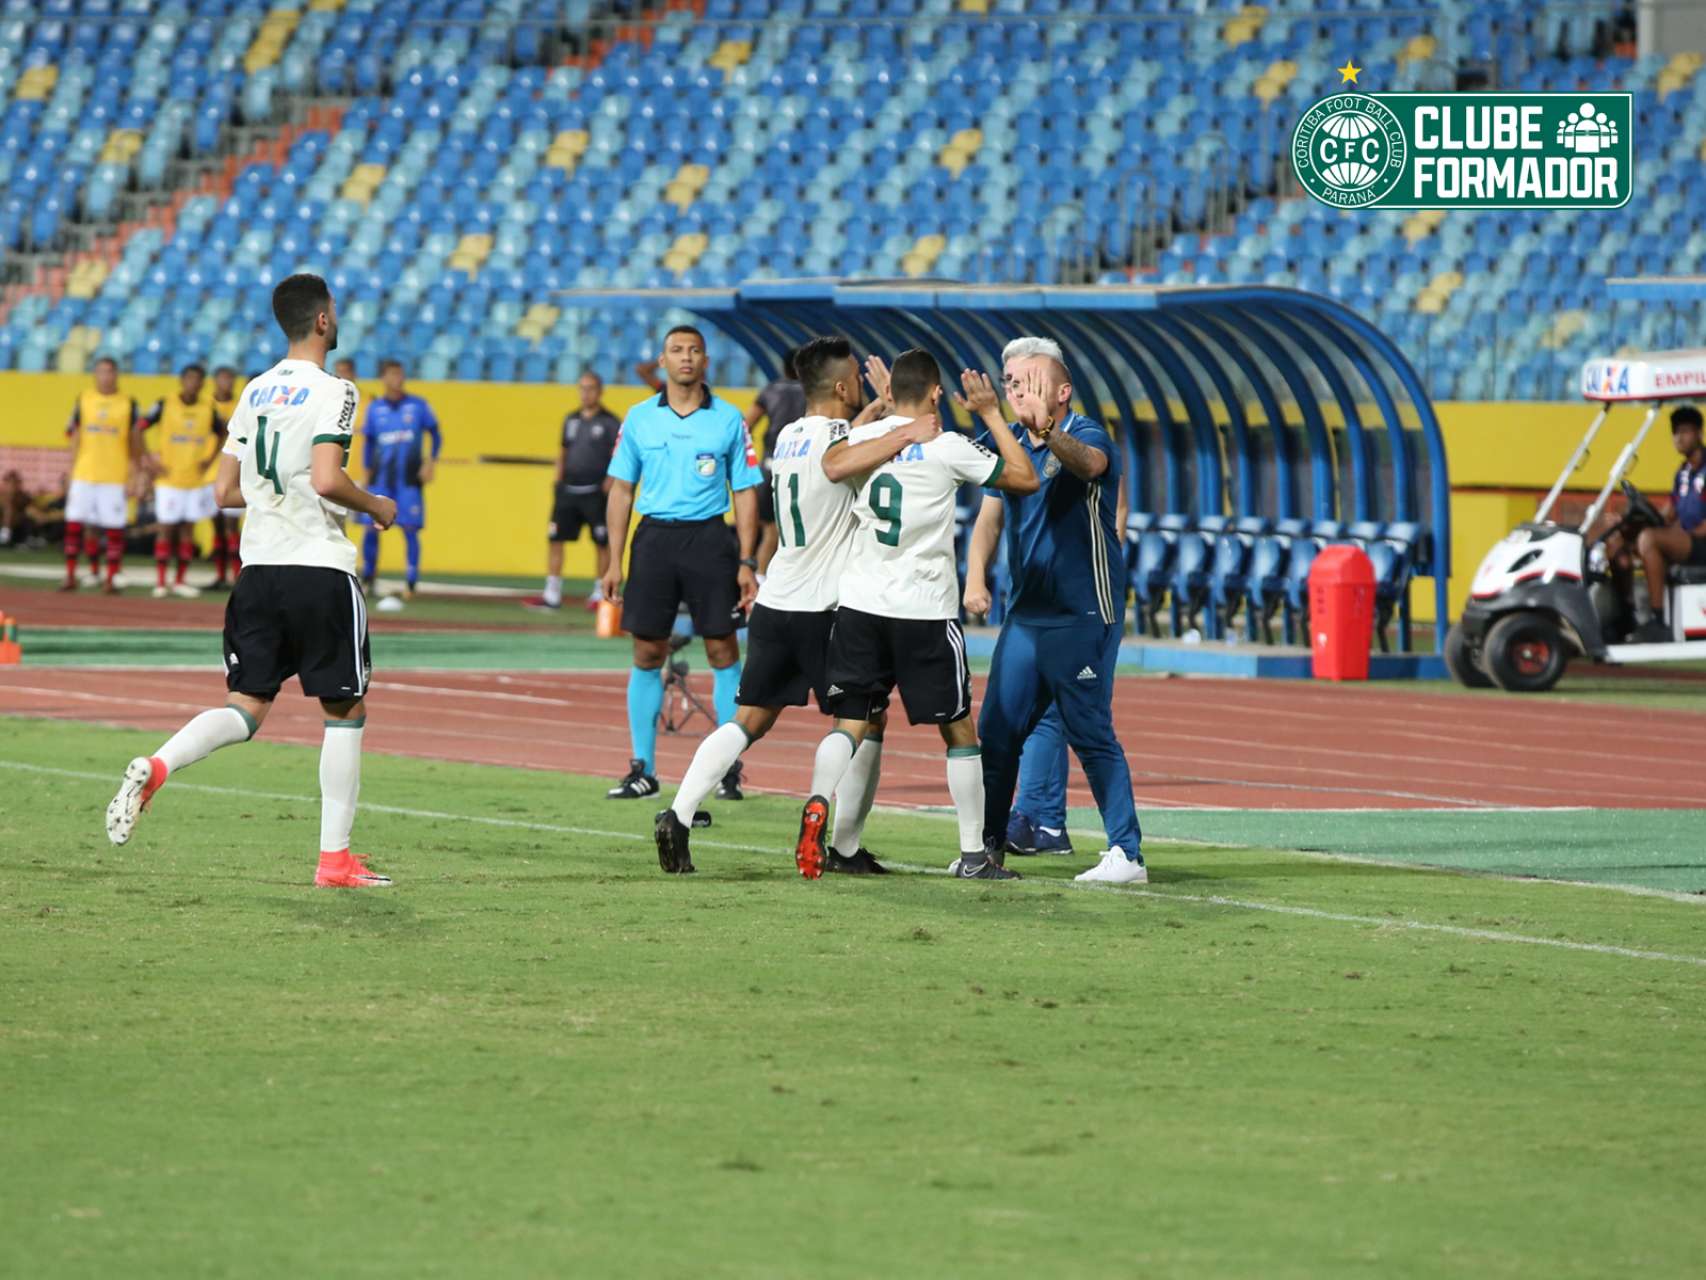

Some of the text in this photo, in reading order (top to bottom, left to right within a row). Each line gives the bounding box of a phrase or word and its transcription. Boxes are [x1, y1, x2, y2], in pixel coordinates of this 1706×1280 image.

[255, 415, 284, 495] 4
[774, 473, 806, 548] 11
[868, 472, 904, 548] 9
